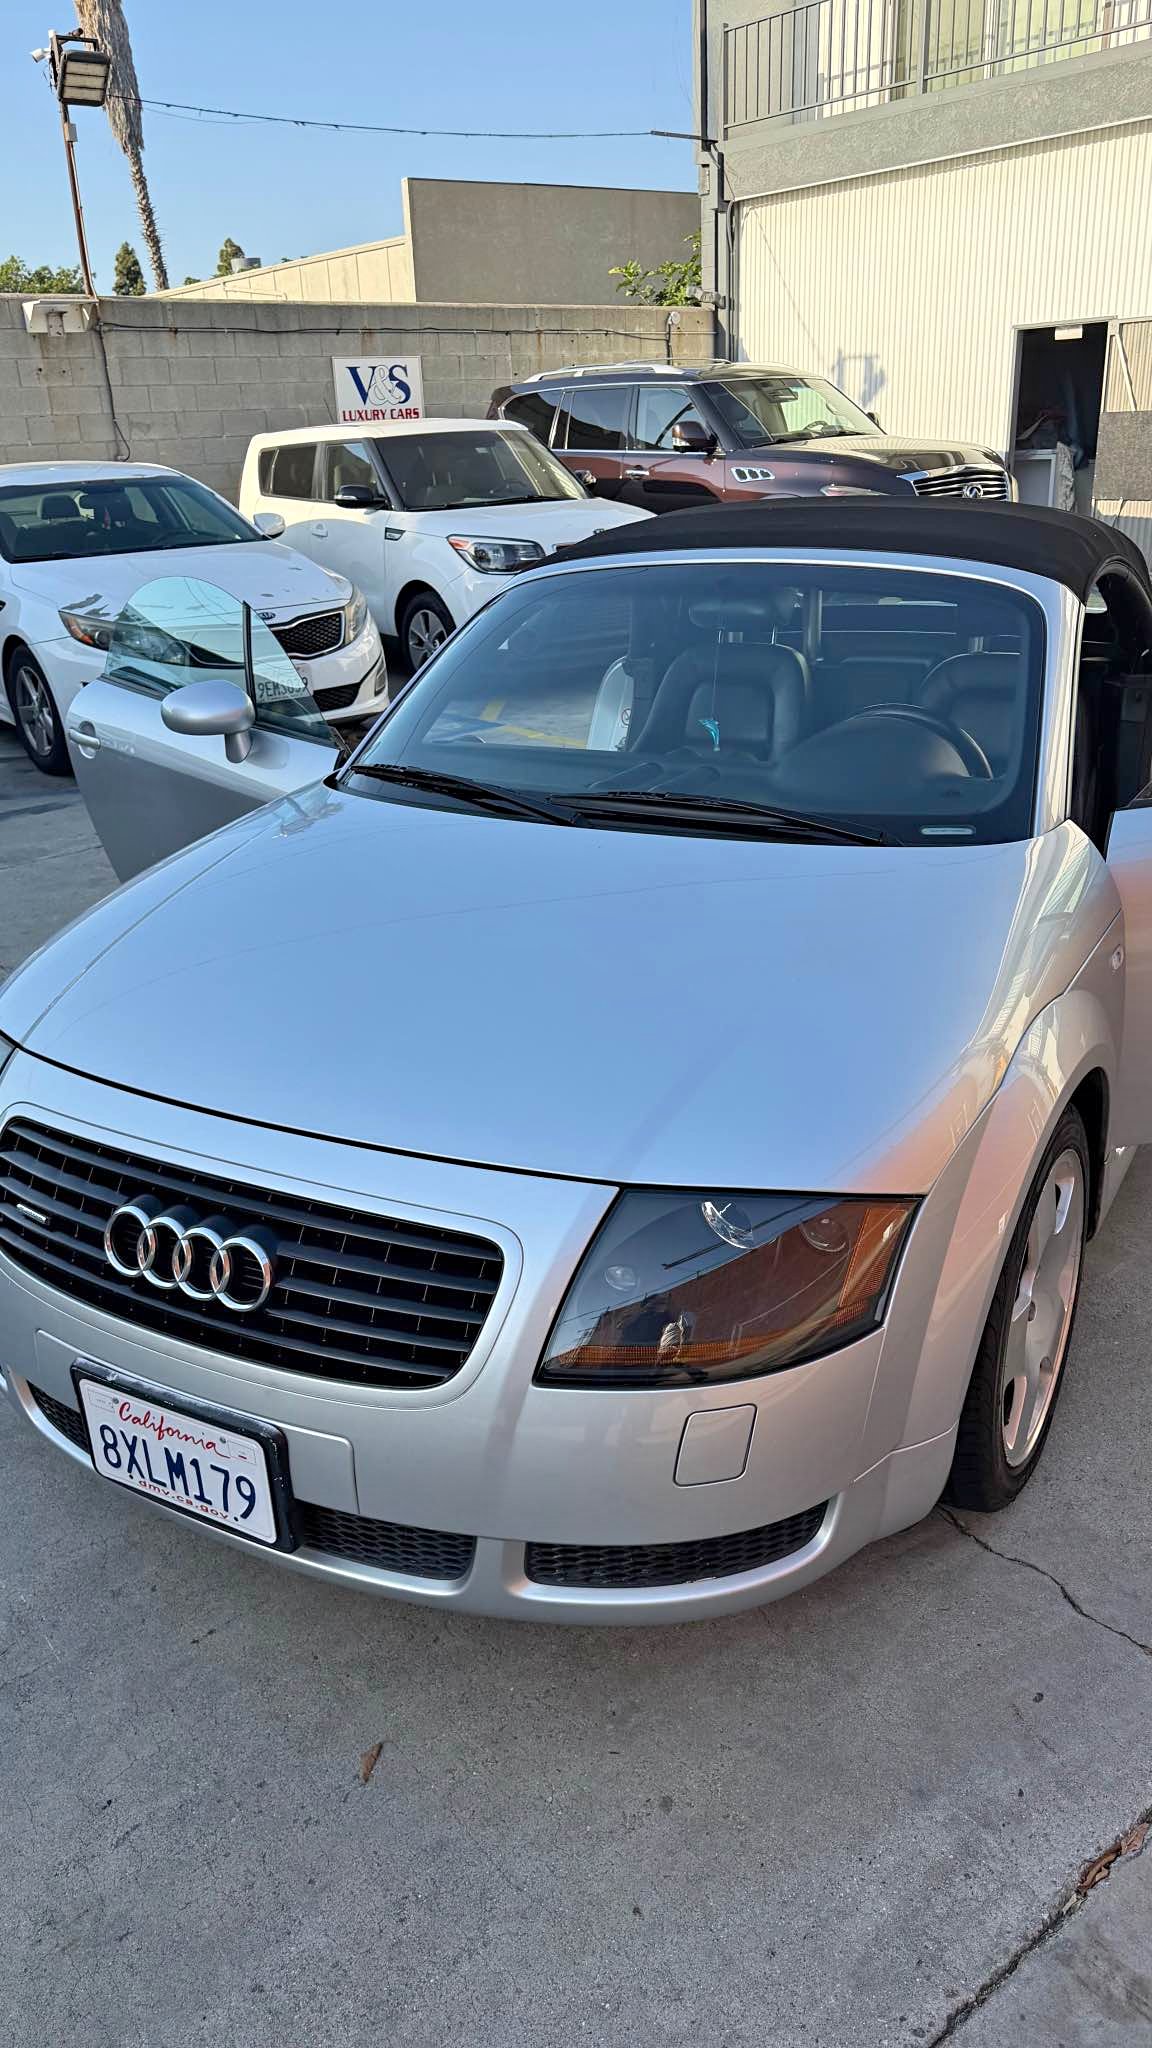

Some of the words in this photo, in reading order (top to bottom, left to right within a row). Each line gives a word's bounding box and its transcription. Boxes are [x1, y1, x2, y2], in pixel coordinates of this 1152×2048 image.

[345, 364, 411, 406] V&S
[342, 409, 387, 421] LUXURY
[390, 407, 420, 420] CARS
[118, 1402, 230, 1459] California
[99, 1424, 256, 1520] 8XLM179
[138, 1479, 229, 1520] dmv.ca.gov
